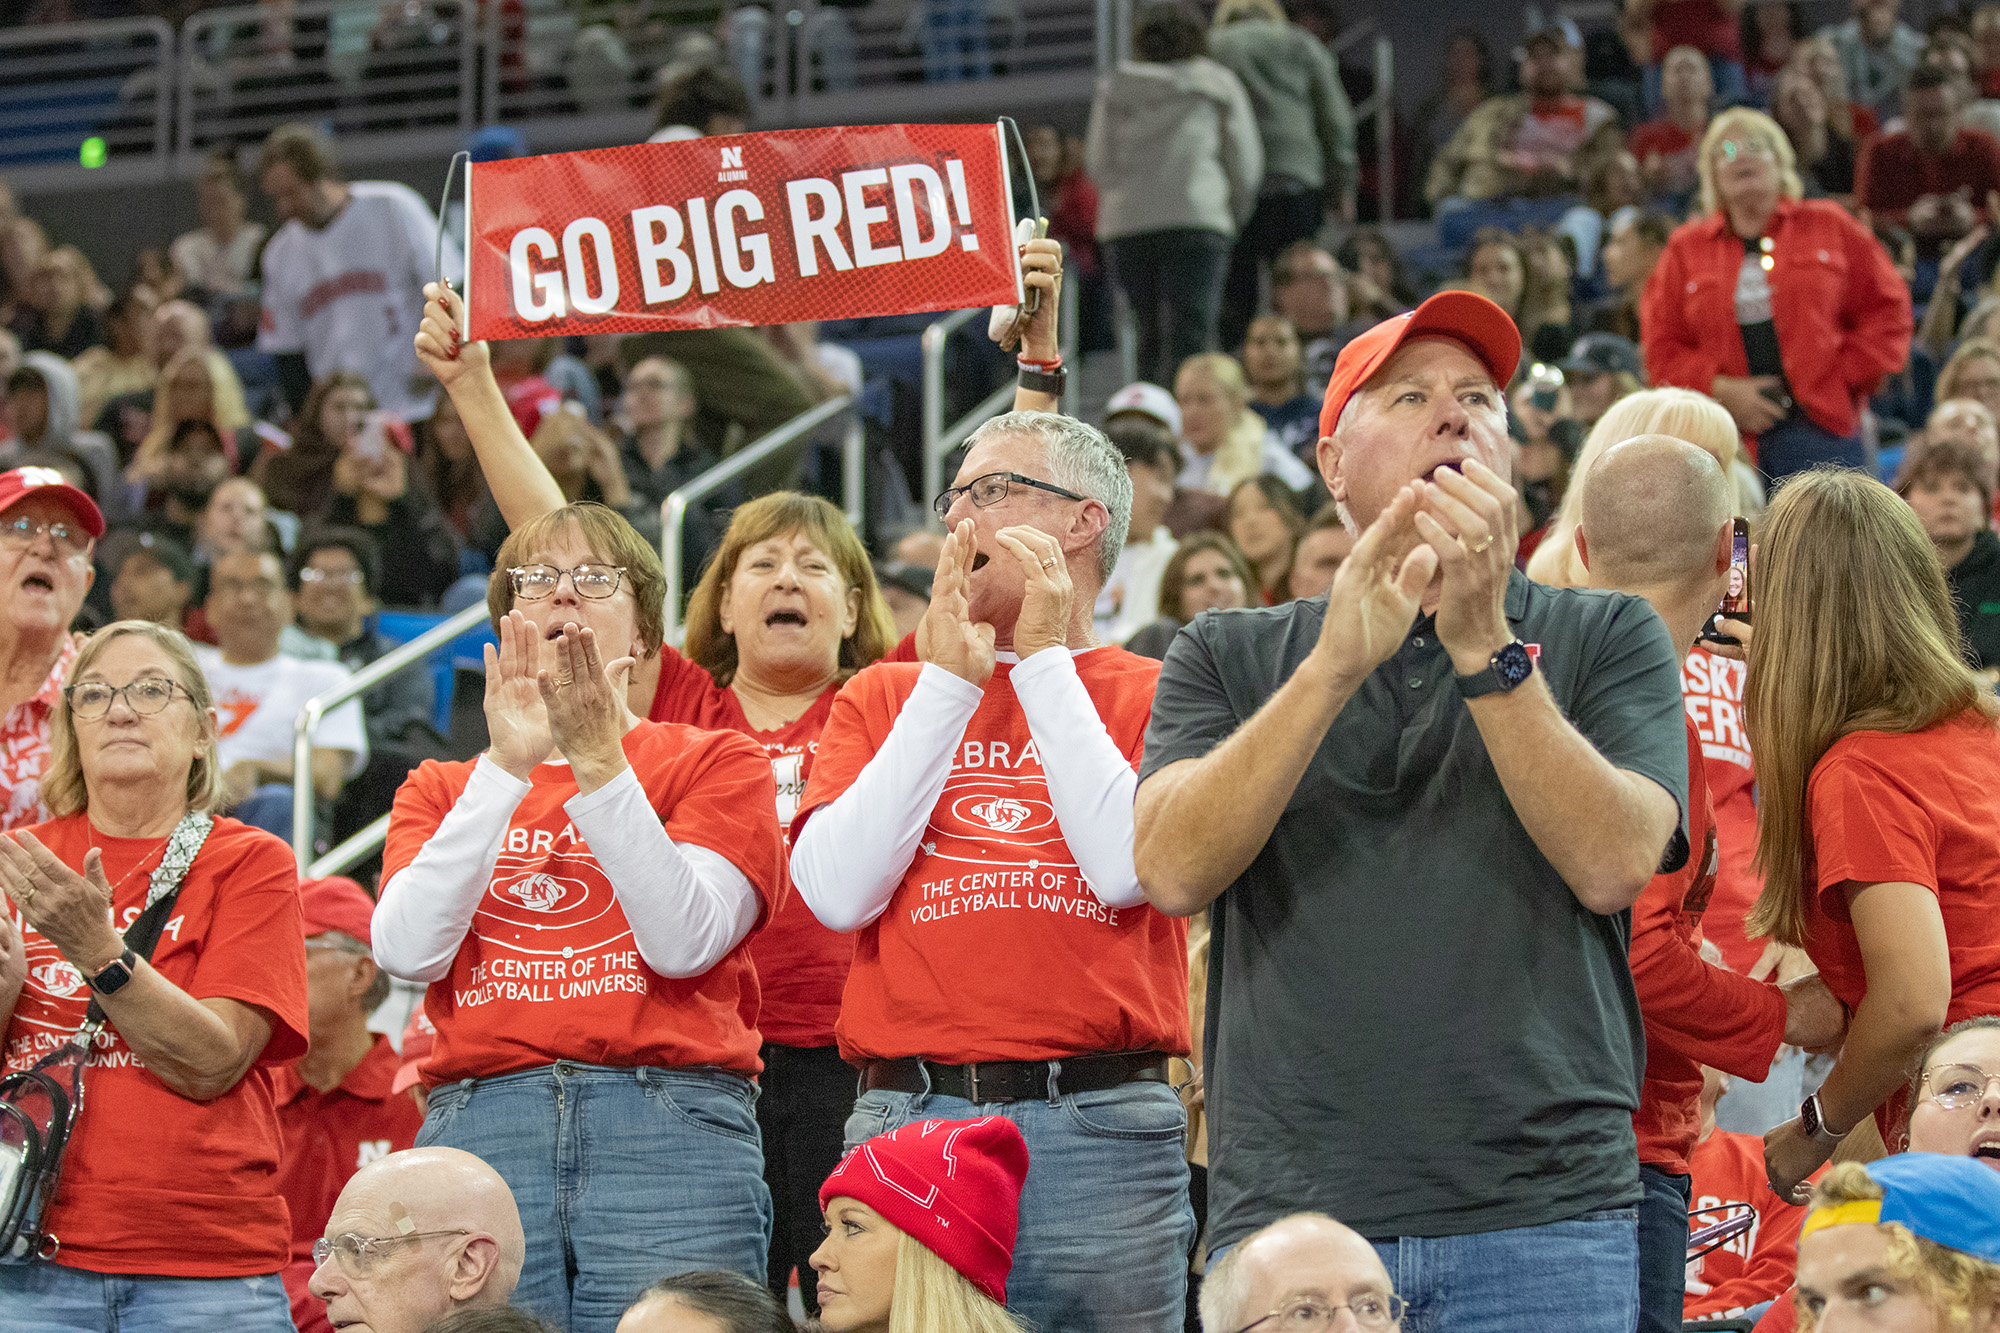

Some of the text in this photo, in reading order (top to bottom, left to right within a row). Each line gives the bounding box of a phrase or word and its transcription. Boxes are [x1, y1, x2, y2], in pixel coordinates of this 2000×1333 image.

[720, 145, 743, 169] N
[717, 170, 748, 182] ALUMNI
[509, 217, 620, 322] GO
[631, 189, 776, 305] BIG
[786, 159, 980, 278] RED!
[921, 877, 954, 901] THE
[959, 872, 1034, 892] CENTER
[1040, 872, 1067, 891] OF
[910, 891, 1120, 927] VOLLEYBALL UNIVERSE
[470, 951, 638, 986] THE CENTER OF THE
[455, 973, 647, 1008] VOLLEYBALL UNIVERSE!
[95, 1031, 119, 1049] OF
